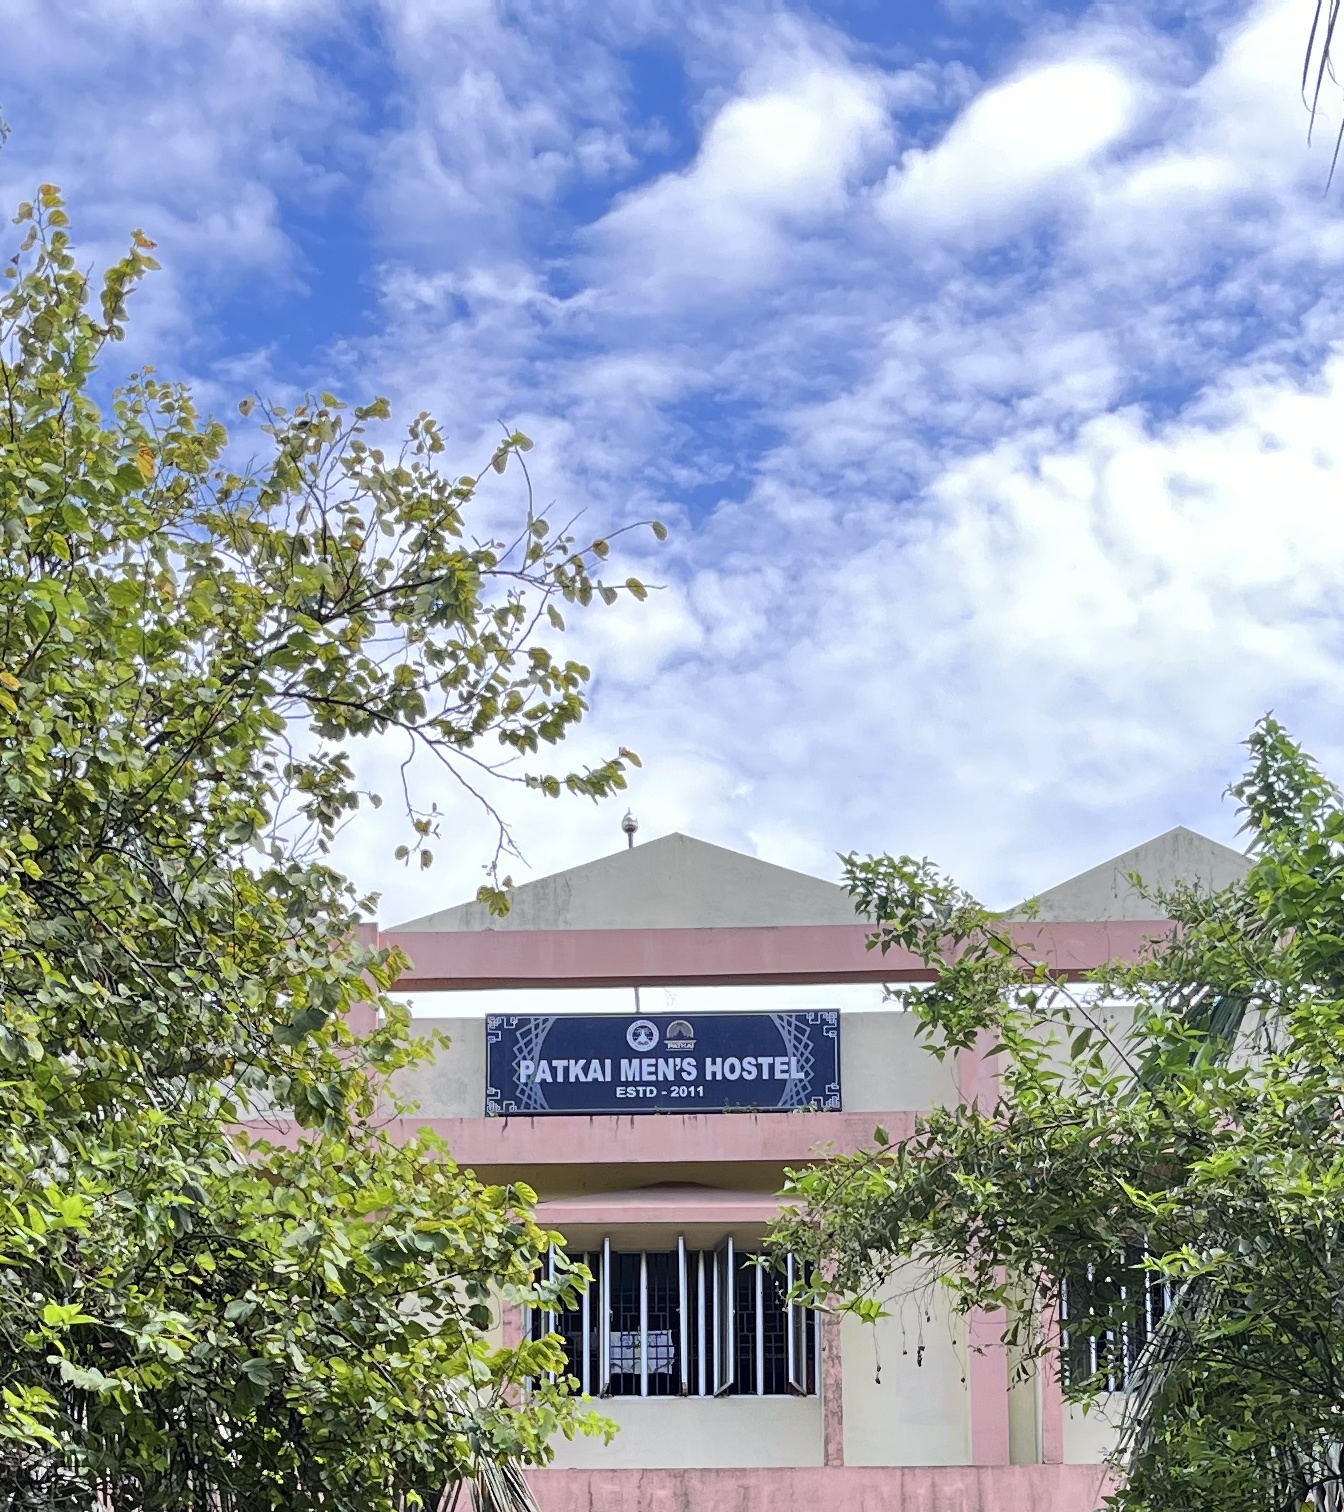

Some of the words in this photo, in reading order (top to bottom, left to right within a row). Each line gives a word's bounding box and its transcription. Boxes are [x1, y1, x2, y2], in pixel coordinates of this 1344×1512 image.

[519, 1059, 611, 1083] PATKAI
[620, 1057, 697, 1082] MEN'S
[706, 1056, 805, 1081] HOSTEL
[616, 1086, 656, 1098] ESTD
[670, 1085, 704, 1098] 2011
